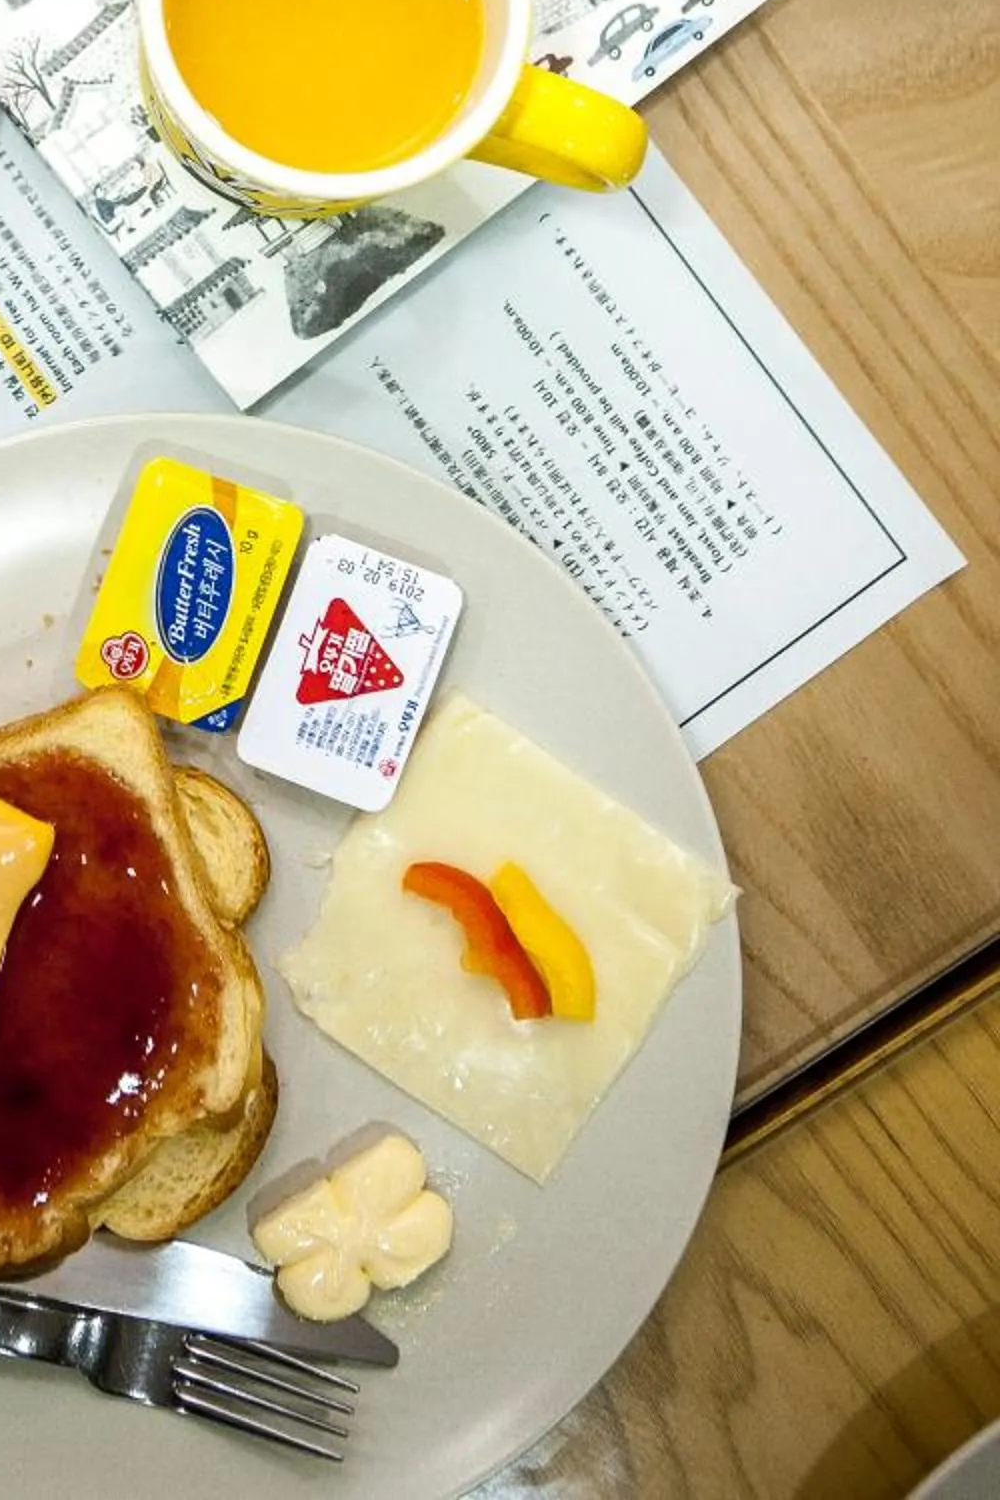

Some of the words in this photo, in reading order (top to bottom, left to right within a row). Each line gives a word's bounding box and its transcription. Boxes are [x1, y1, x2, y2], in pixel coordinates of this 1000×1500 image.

[3, 299, 24, 324] free
[21, 289, 40, 313] has
[0, 333, 16, 350] ID
[21, 325, 38, 345] for
[38, 312, 64, 345] room
[35, 344, 73, 393] Internet
[62, 345, 85, 375] Each
[598, 396, 613, 414] be
[592, 424, 616, 455] Time
[608, 413, 629, 436] will
[628, 437, 659, 477] Coffee
[655, 477, 678, 500] and
[676, 501, 698, 527] Jam
[667, 526, 712, 584] Breakfast
[167, 521, 202, 647] ButterFresh
[193, 538, 230, 639] 버터후레시
[327, 626, 372, 695] 딸기잼
